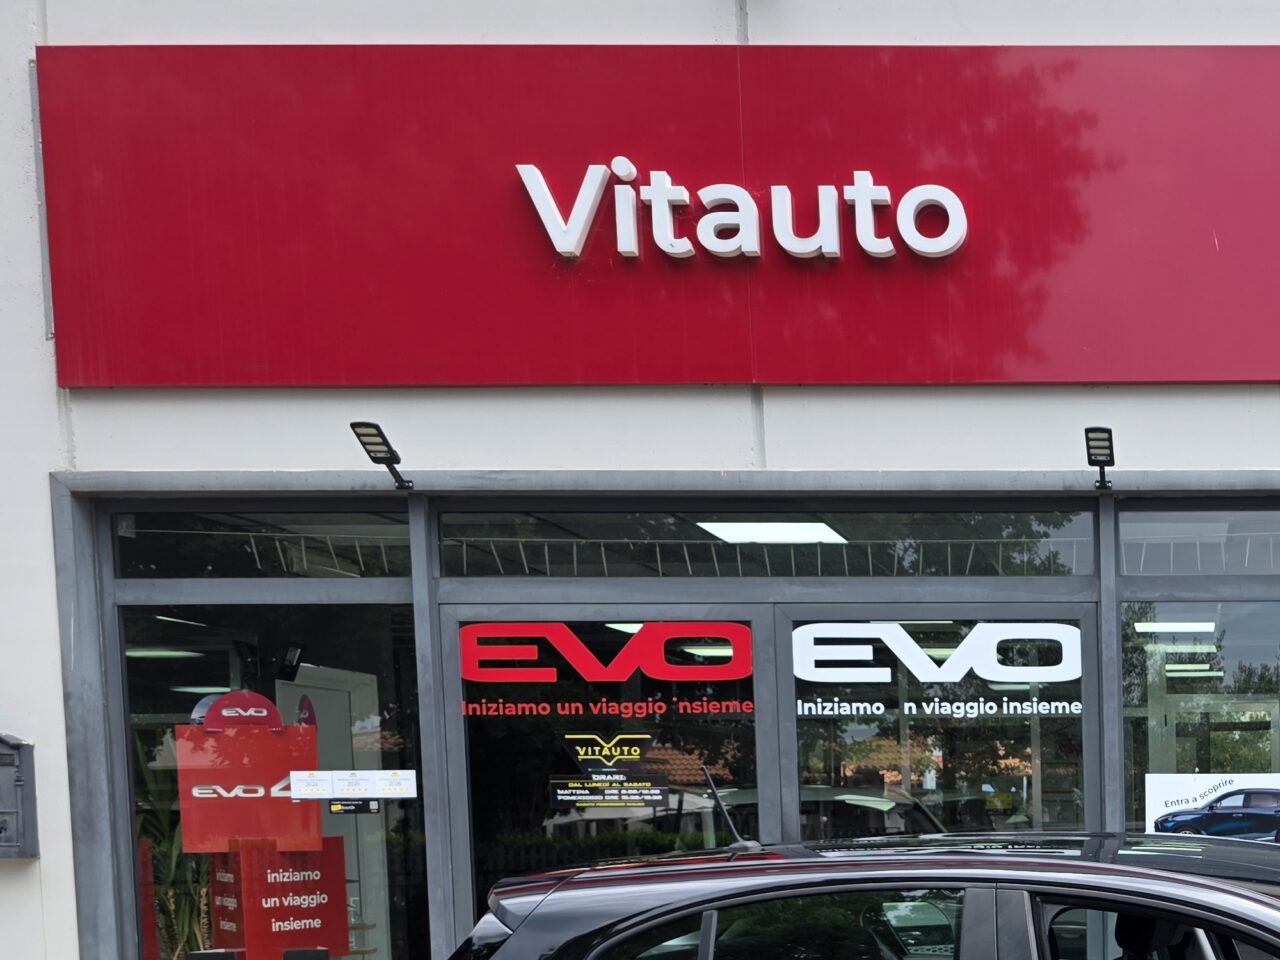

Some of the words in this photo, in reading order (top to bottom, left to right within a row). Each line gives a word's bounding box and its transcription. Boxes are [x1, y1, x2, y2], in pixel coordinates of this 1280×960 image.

[515, 156, 967, 258] Vitauto
[459, 622, 753, 682] EVO
[792, 623, 1082, 682] EVO
[221, 708, 268, 717] EVO
[460, 698, 550, 716] Iniziamo
[557, 702, 584, 715] un
[589, 697, 666, 718] viaggio
[672, 696, 754, 714] nsieme
[796, 697, 885, 716] Iniziamo
[922, 697, 998, 718] viaggio
[1002, 696, 1083, 715] insieme
[576, 746, 640, 756] VITAUTO
[192, 785, 265, 798] EVO
[1164, 798, 1190, 808] Entra
[1199, 779, 1234, 800] scoprire
[267, 868, 321, 883] iniziamo
[262, 897, 280, 908] un
[282, 891, 328, 908] viaggio
[271, 917, 322, 932] insieme
